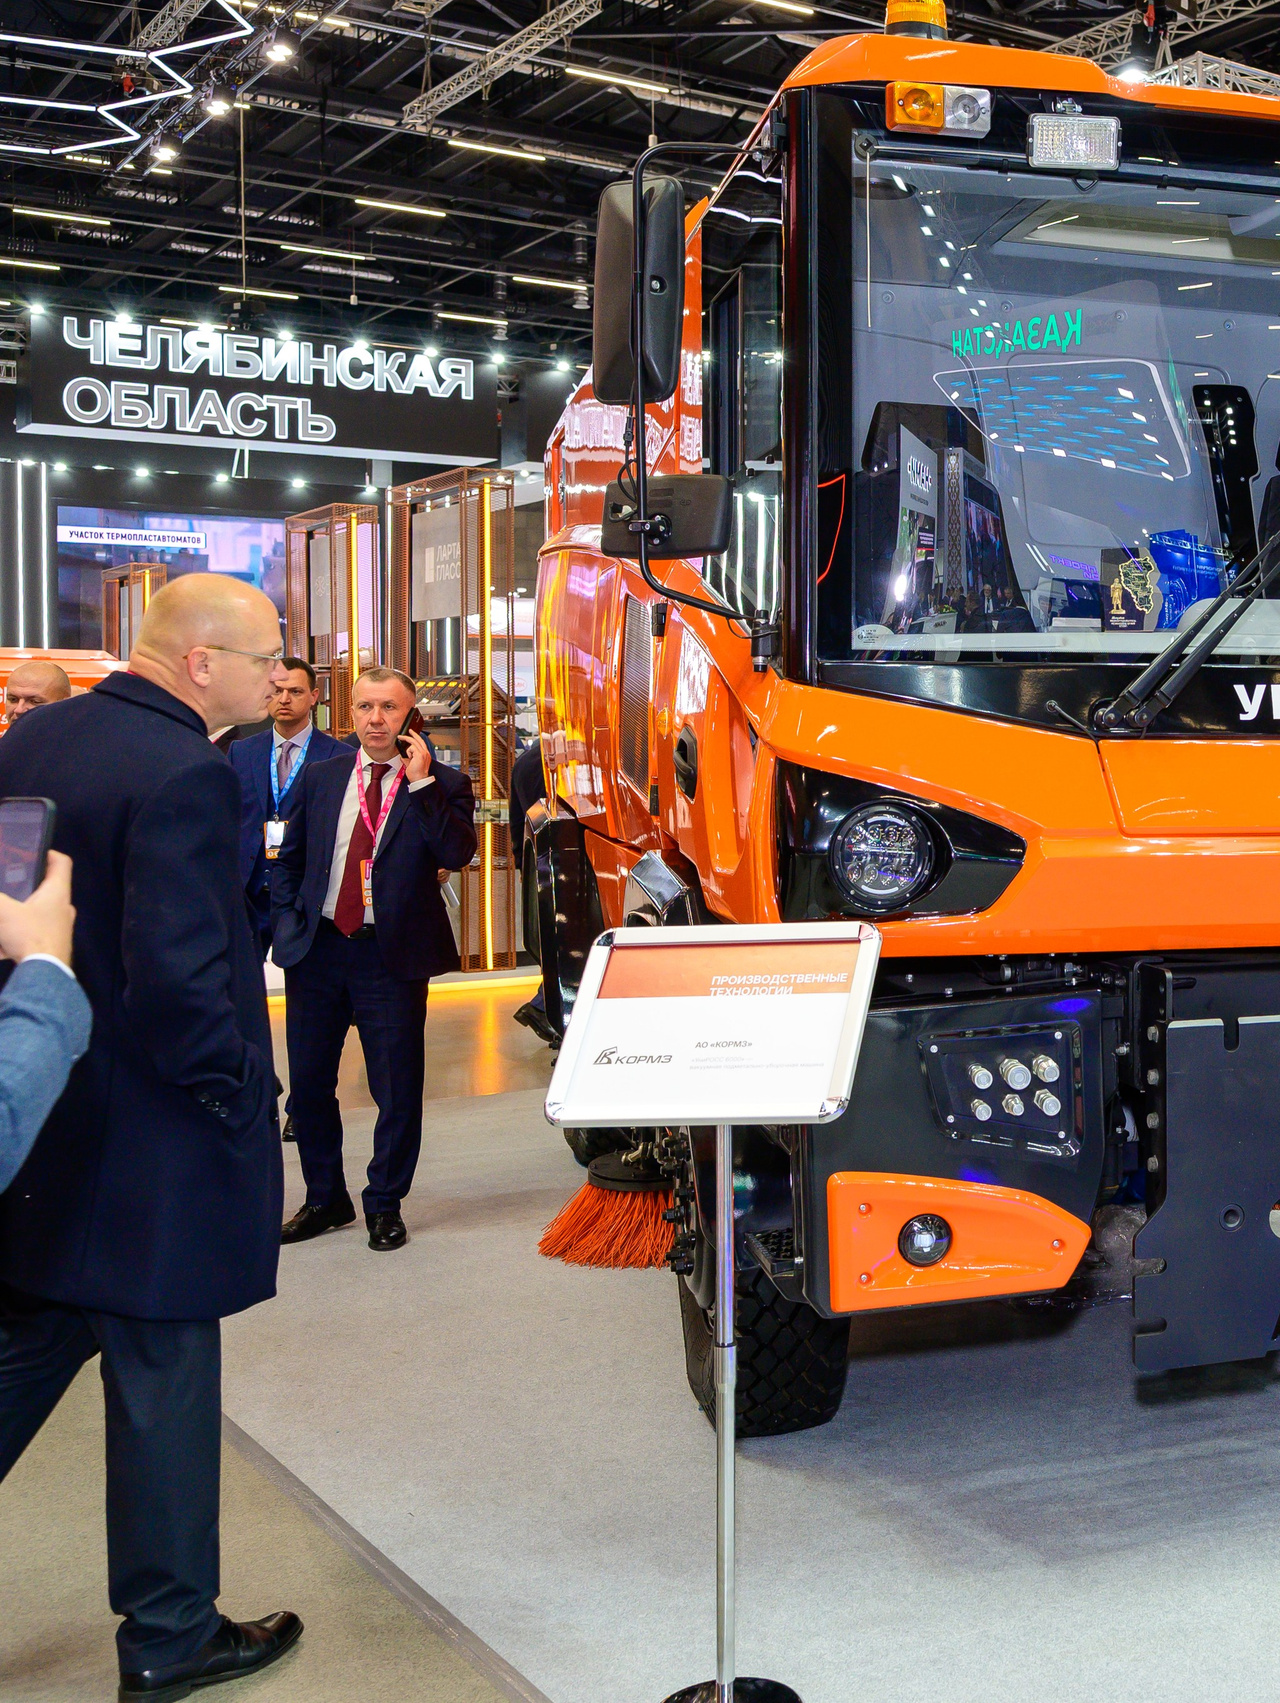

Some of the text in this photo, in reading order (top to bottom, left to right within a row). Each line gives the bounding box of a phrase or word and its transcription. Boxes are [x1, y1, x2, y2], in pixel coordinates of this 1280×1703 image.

[62, 316, 474, 400] ЧЕЛЯБИНСКАЯ
[62, 376, 337, 442] ОБЛАСТЬ
[69, 530, 201, 544] УЧАСТОК ТЕРМОПЛАСТАВТОМАТОВ
[711, 972, 848, 986] ПРОИЗВОДСТВЕННЫЕ
[709, 986, 793, 997] ТЕХНОЛОГИИ
[695, 1041, 709, 1049] АО
[614, 1055, 672, 1065] КОРМЗ
